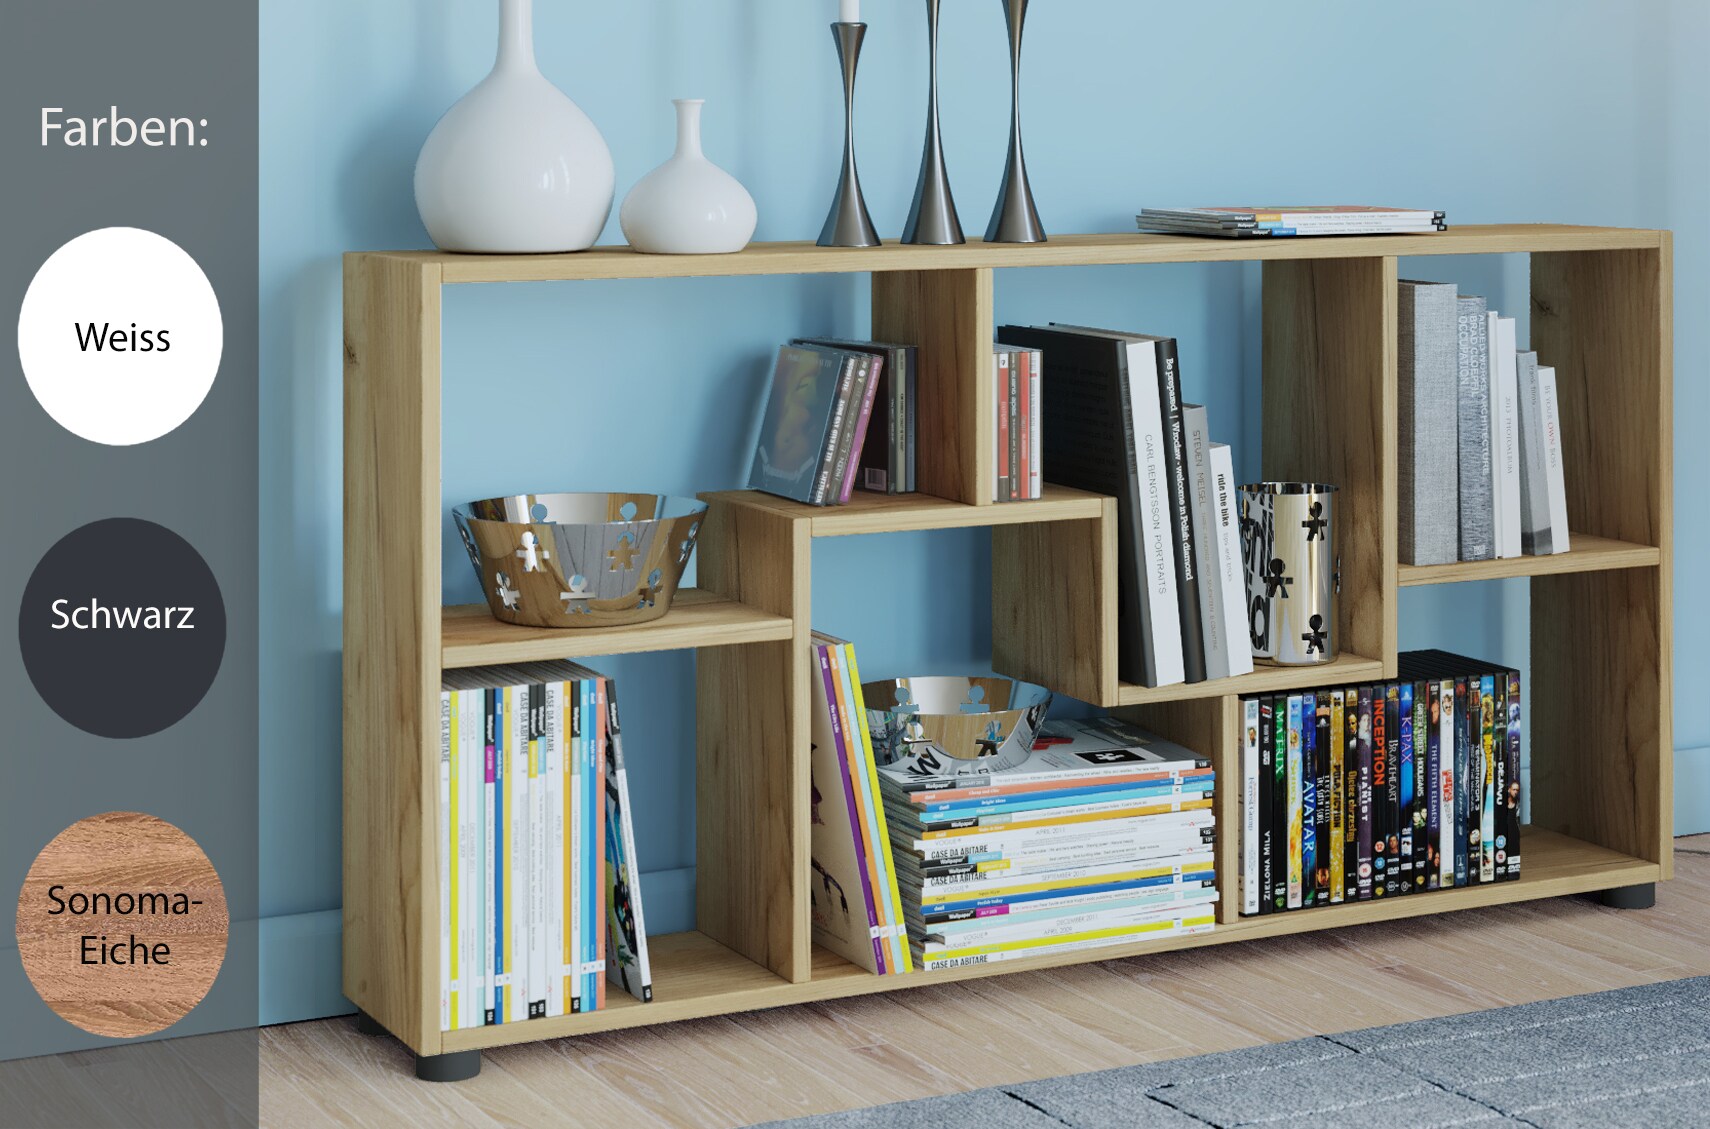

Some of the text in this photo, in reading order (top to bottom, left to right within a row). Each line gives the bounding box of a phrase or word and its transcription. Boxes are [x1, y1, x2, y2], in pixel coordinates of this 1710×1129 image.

[1166, 358, 1174, 370] Be
[1459, 316, 1469, 386] OCCUPATION
[1469, 315, 1478, 397] BRAD CLOEPFIL
[1165, 372, 1178, 411] prepared
[1478, 314, 1490, 475] ALLIED WORKS ARCHITECTURE
[1193, 429, 1202, 466] STEVEN
[1548, 422, 1556, 445] OWN
[1175, 466, 1185, 505] welcome
[1197, 473, 1206, 507] MEISEL
[1217, 473, 1226, 491] ride
[1219, 492, 1228, 506] the
[1145, 434, 1167, 594] CARL BENGTSSON PORTRAITS
[1179, 506, 1187, 514] in
[1180, 514, 1190, 541] Polish
[1220, 509, 1230, 527] bike
[1183, 542, 1194, 581] diamond
[441, 700, 449, 762] CASE DA ABITARE
[520, 692, 528, 755] CASE DA ABITARE
[546, 690, 554, 753] CASE DA ABITARE
[1401, 717, 1412, 764] K-PAX
[1275, 710, 1284, 774] MATRIX
[1373, 700, 1385, 785] INCEPTION
[1416, 703, 1425, 797] GREEN STREET HOOLIGANS
[1388, 740, 1399, 803] BRAVEHEART
[1303, 781, 1314, 853] AVATAR
[1474, 801, 1480, 811] 3
[931, 844, 988, 860] CASE DA ABITARE
[931, 871, 987, 887] CASE DA ABITARE
[1042, 873, 1072, 882] SEPTEMBER
[1073, 870, 1087, 878] 2010
[1056, 916, 1086, 926] DECEMBER
[1086, 914, 1098, 922] 2011
[931, 955, 988, 971] CASE DA ABITARE
